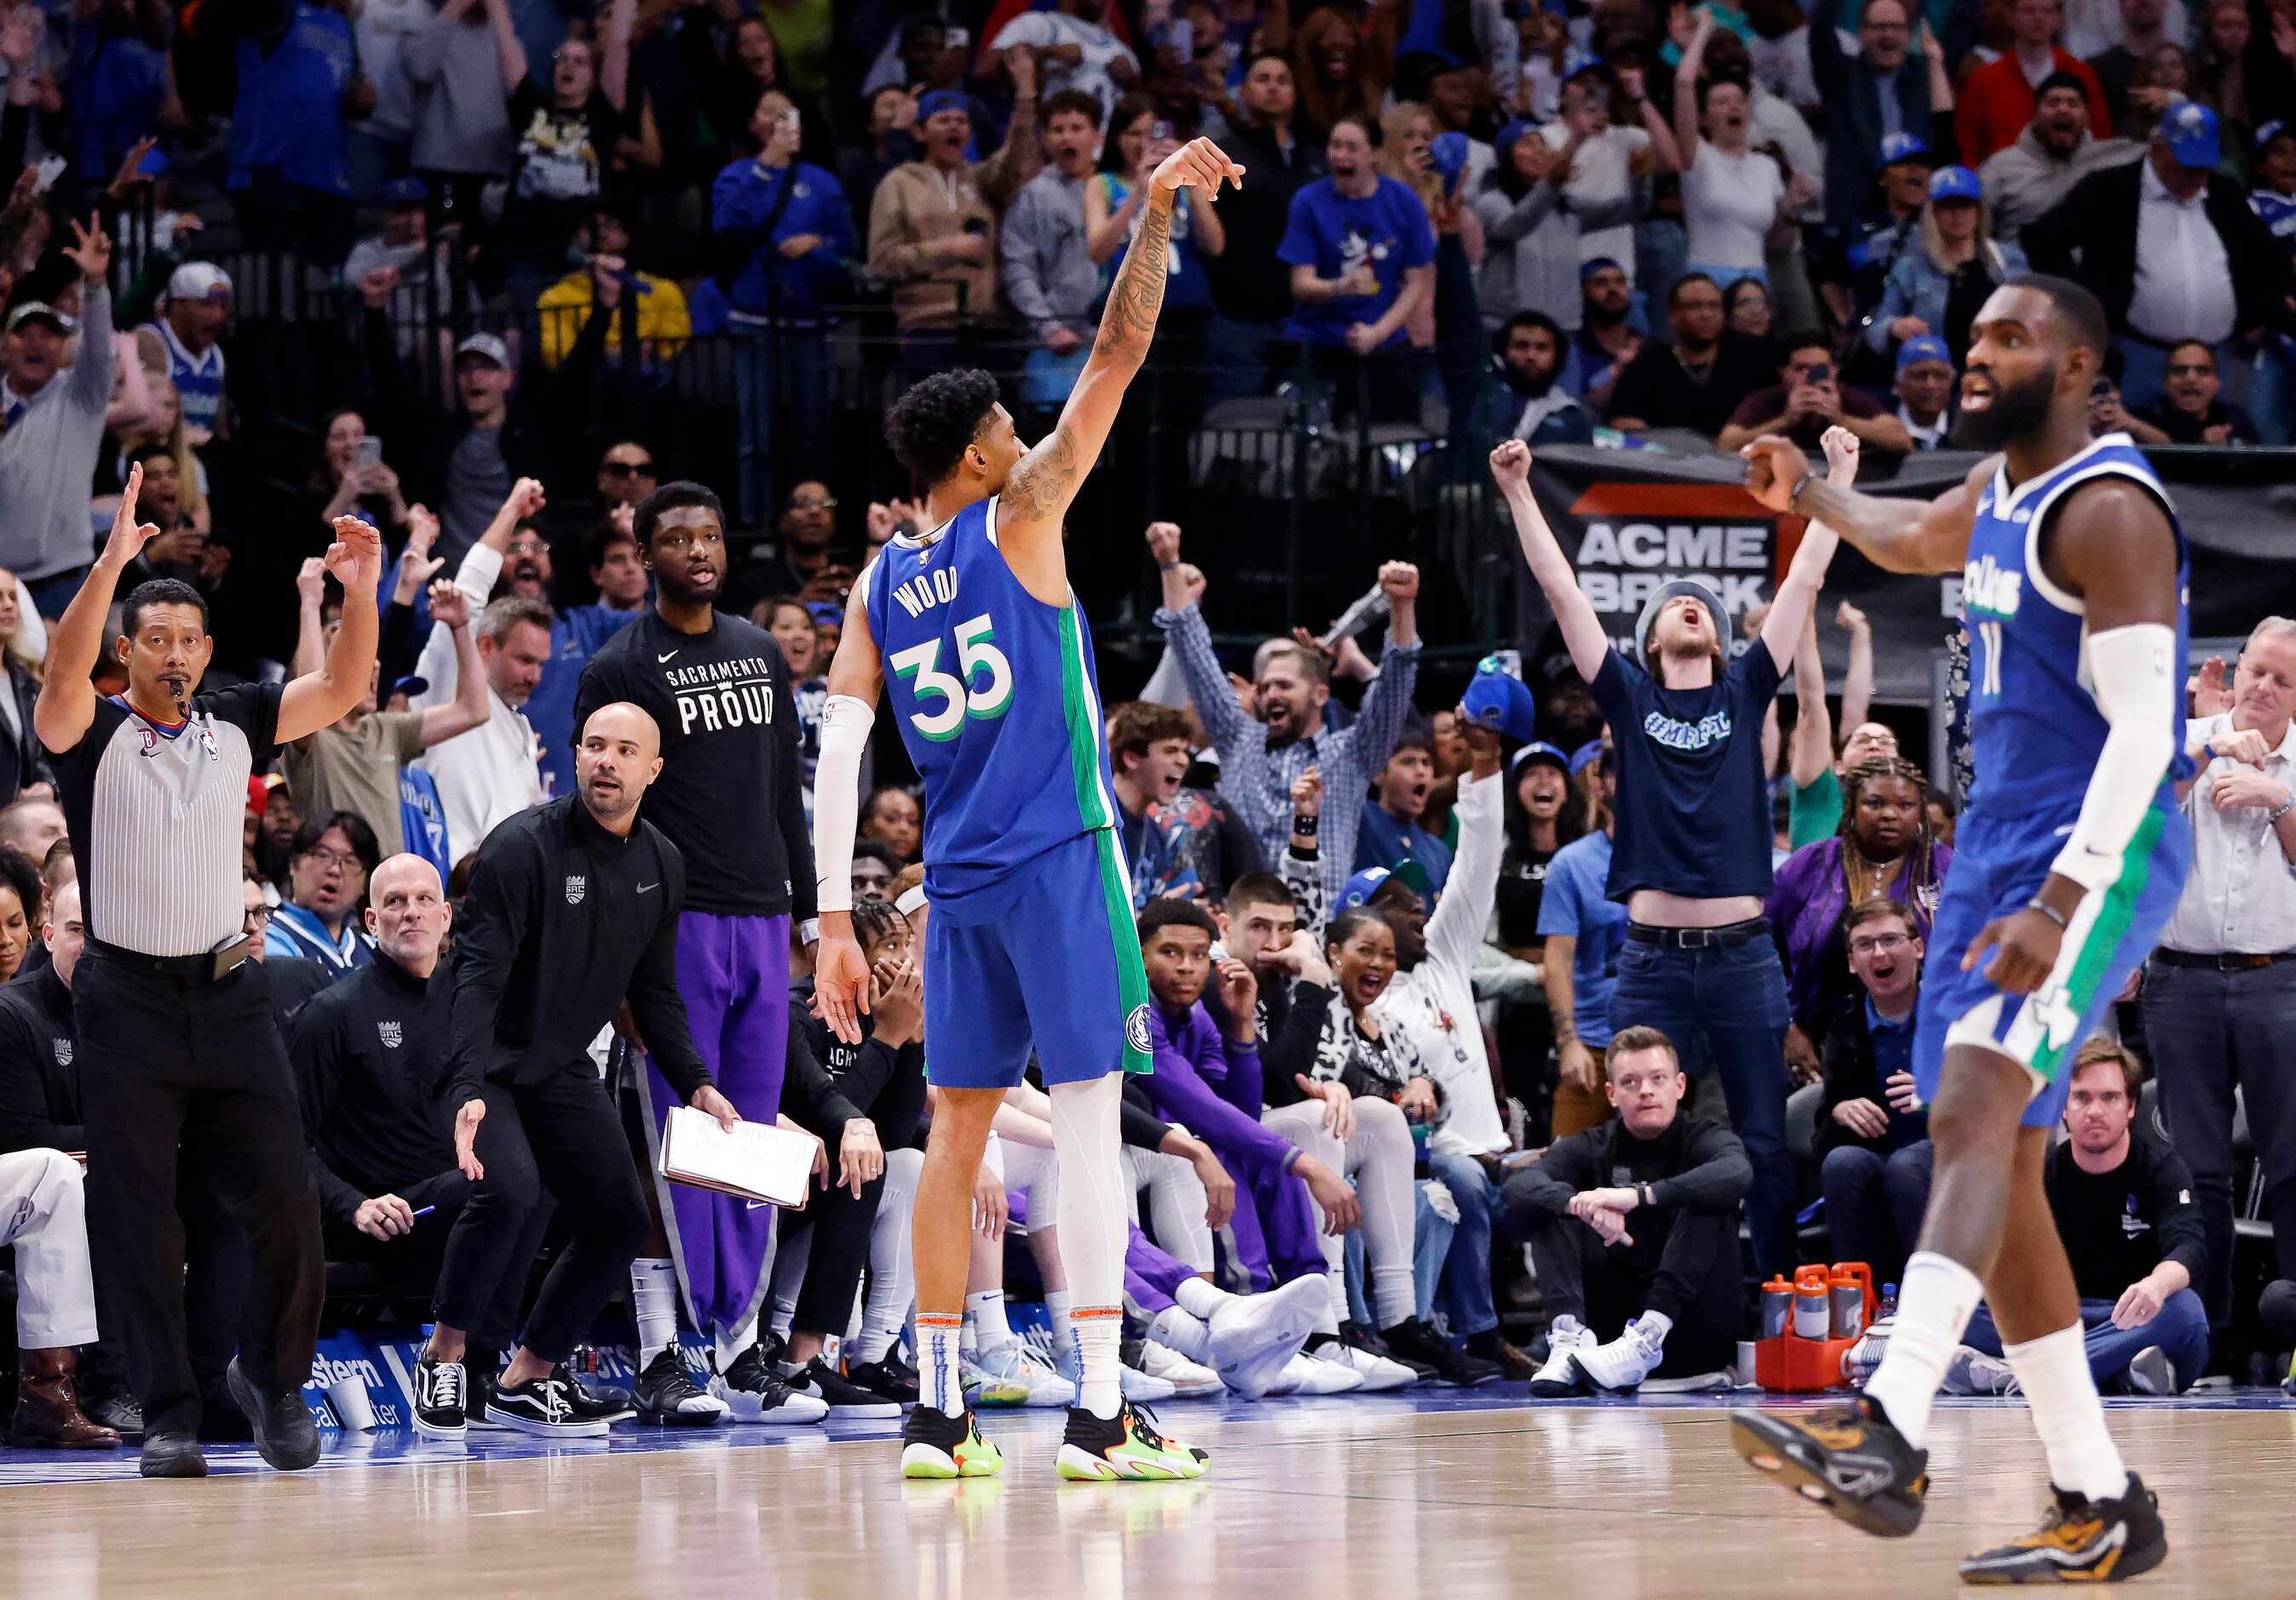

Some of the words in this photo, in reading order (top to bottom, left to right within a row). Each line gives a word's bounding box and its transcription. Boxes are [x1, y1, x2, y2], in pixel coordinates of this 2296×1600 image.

[1577, 522, 1769, 568] ACME
[893, 566, 958, 619] WOOD
[1578, 572, 1767, 615] BRK
[665, 657, 768, 687] SACRAMENTO
[889, 613, 1015, 742] 35
[1978, 622, 2002, 697] 11
[676, 685, 774, 734] PROUD
[566, 885, 585, 894] SAC
[302, 1353, 384, 1390] stern
